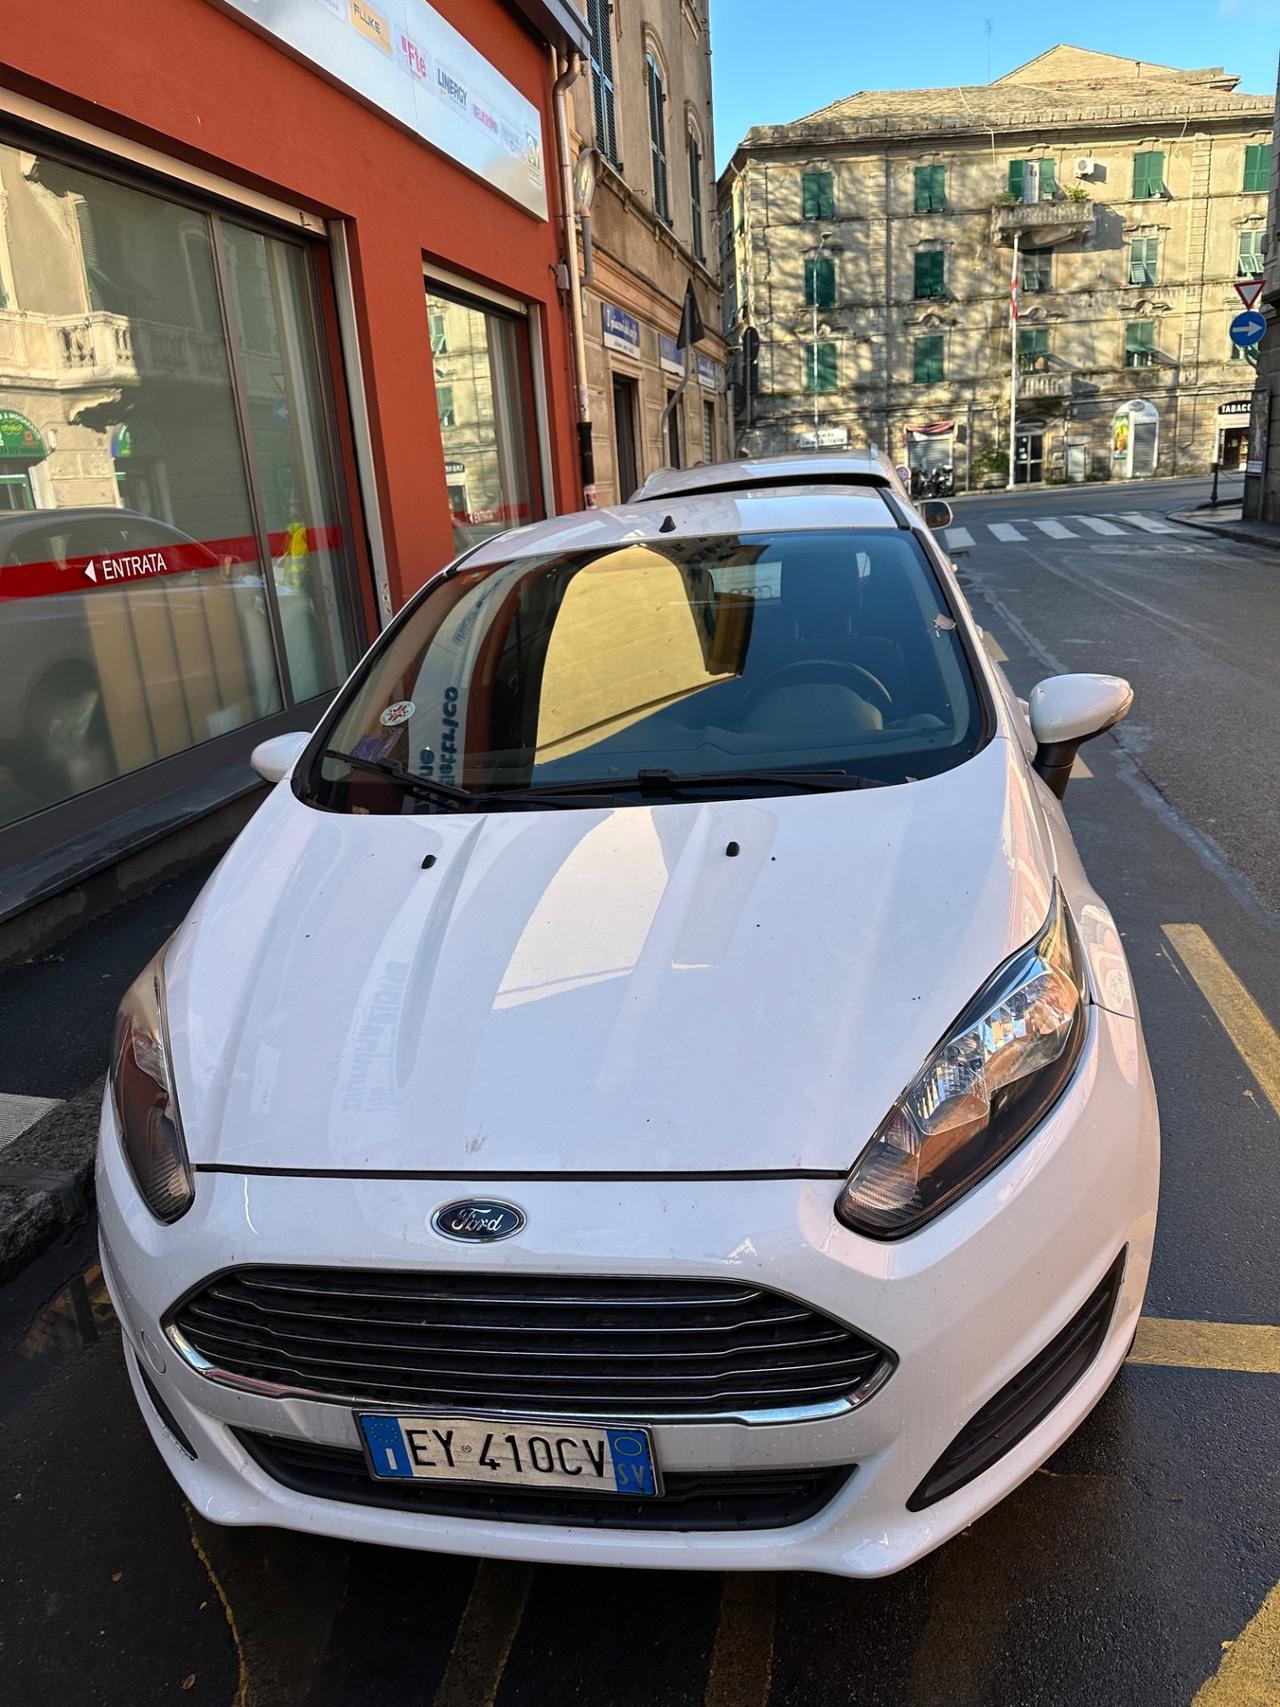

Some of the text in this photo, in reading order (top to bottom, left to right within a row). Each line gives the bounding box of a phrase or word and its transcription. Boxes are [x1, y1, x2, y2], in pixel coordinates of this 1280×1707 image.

[353, 3, 381, 34] FLUKE
[437, 68, 468, 106] LINERGY
[102, 552, 168, 581] ENTRATA
[451, 1207, 504, 1232] Ford
[405, 1428, 605, 1479] EY 410CV
[616, 1462, 646, 1494] SV
